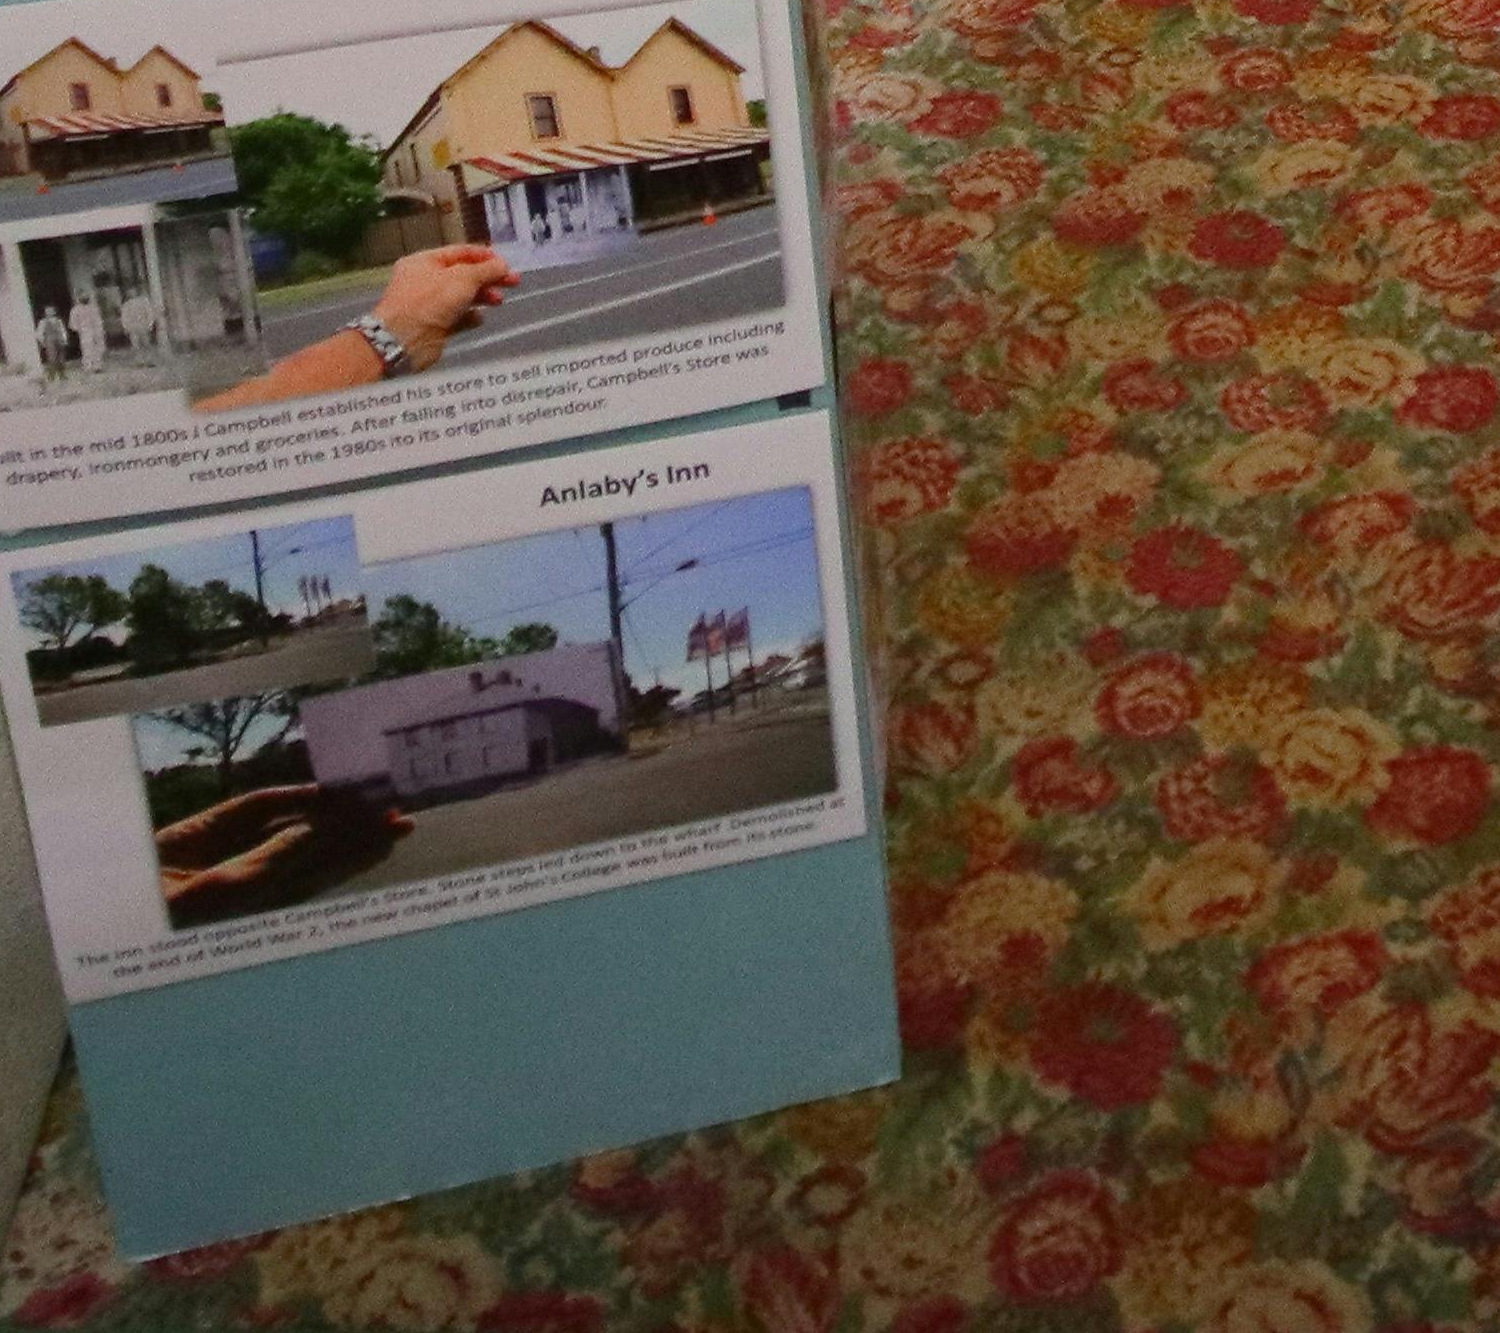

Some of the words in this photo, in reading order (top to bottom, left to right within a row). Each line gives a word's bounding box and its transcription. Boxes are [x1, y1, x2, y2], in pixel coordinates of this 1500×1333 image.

[5, 467, 82, 485] drapery,
[88, 448, 210, 474] ironmongery
[215, 438, 250, 457] and
[254, 426, 344, 454] groceries.
[350, 415, 397, 434] After
[400, 404, 456, 423] falling
[460, 397, 497, 412] into
[500, 380, 582, 405] disrepair,
[586, 362, 681, 389] Campbell’s
[685, 352, 731, 371] Store
[734, 345, 769, 361] was
[29, 448, 47, 460] in
[50, 444, 84, 458] the
[88, 435, 126, 452] mid
[131, 428, 188, 448] 1800s
[203, 410, 292, 437] Campbell
[296, 390, 402, 421] established
[405, 386, 432, 400] his
[437, 377, 484, 396] store
[486, 373, 508, 386] to
[511, 364, 541, 382] sell
[545, 348, 628, 375] imported
[632, 338, 703, 363] produce
[707, 320, 785, 345] including
[188, 457, 267, 482] restored
[272, 457, 289, 469] in
[293, 450, 325, 465] the
[331, 438, 386, 460] 1980s
[417, 429, 440, 442] its
[444, 412, 511, 437] original
[540, 468, 658, 507] Anlaby’s
[666, 463, 709, 484] Inn
